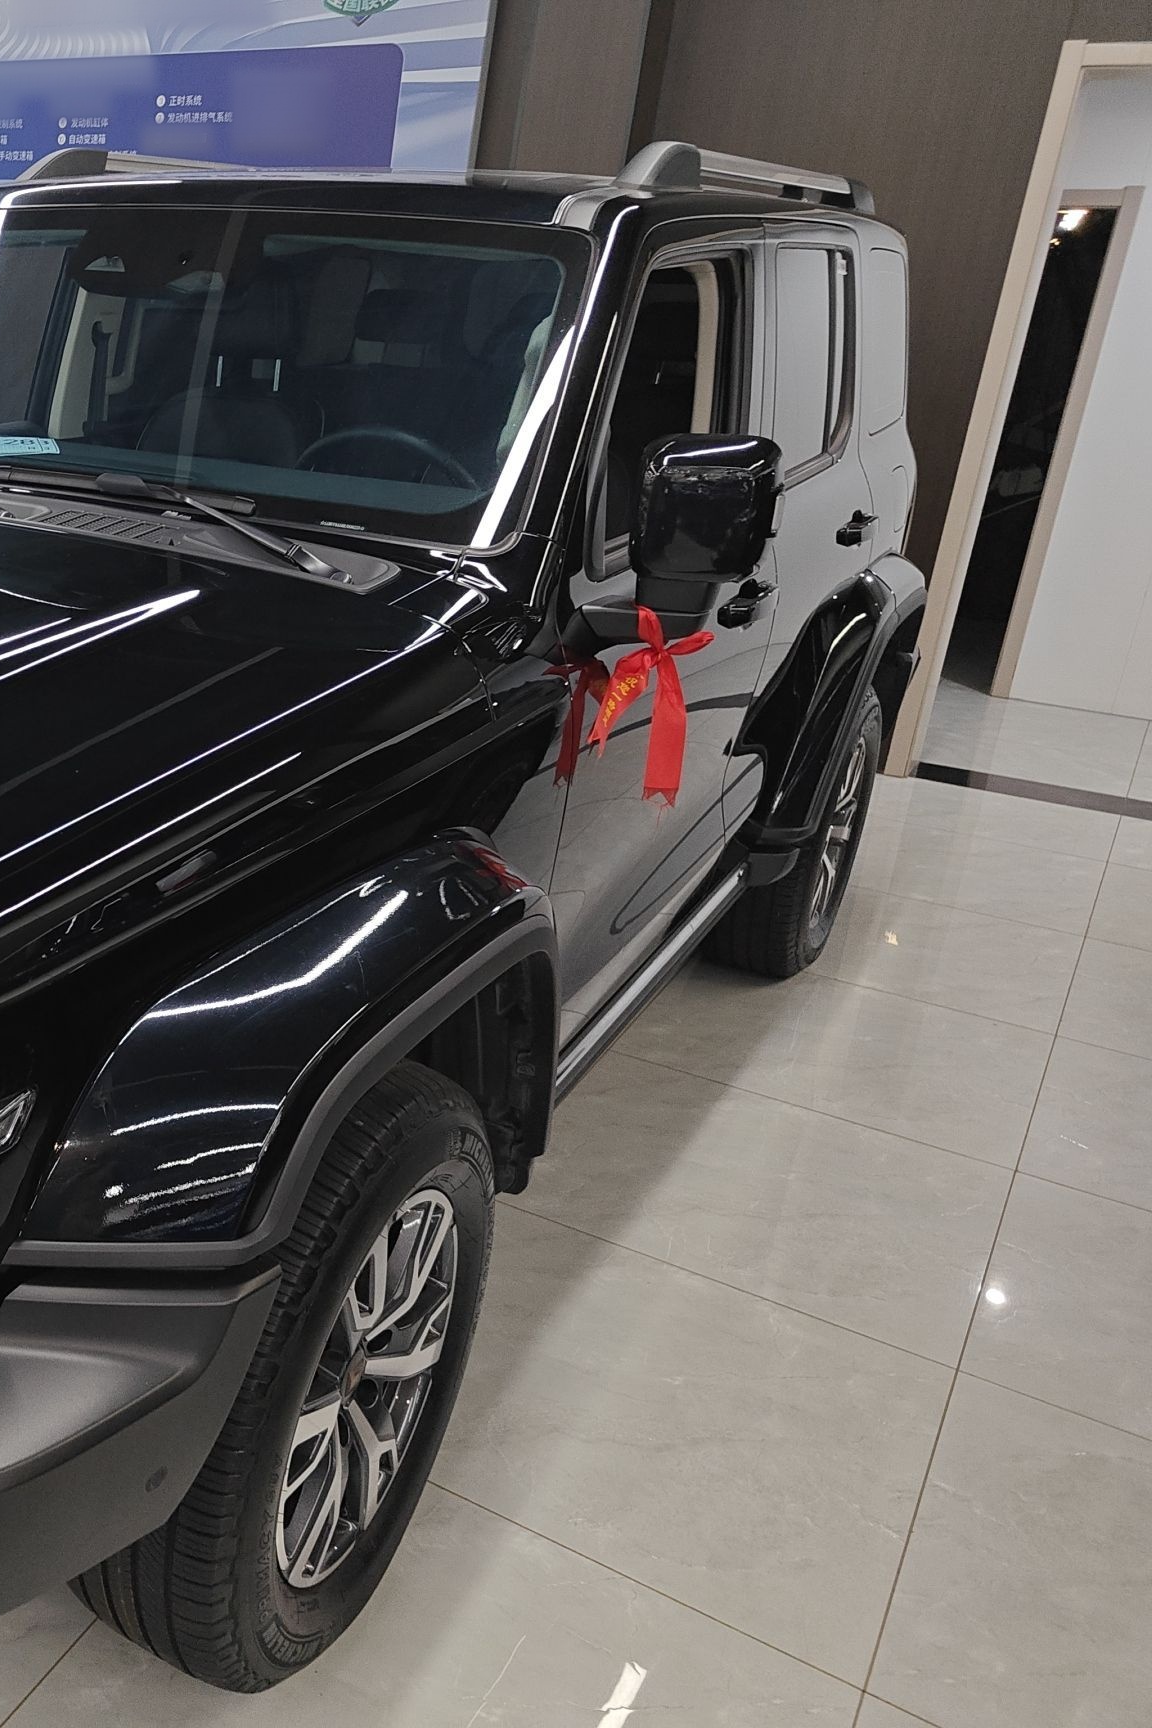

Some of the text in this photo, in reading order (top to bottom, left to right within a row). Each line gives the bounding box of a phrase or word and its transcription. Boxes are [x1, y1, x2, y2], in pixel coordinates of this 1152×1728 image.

[169, 95, 202, 106] 正时系统
[69, 134, 106, 145] 自动变速箱
